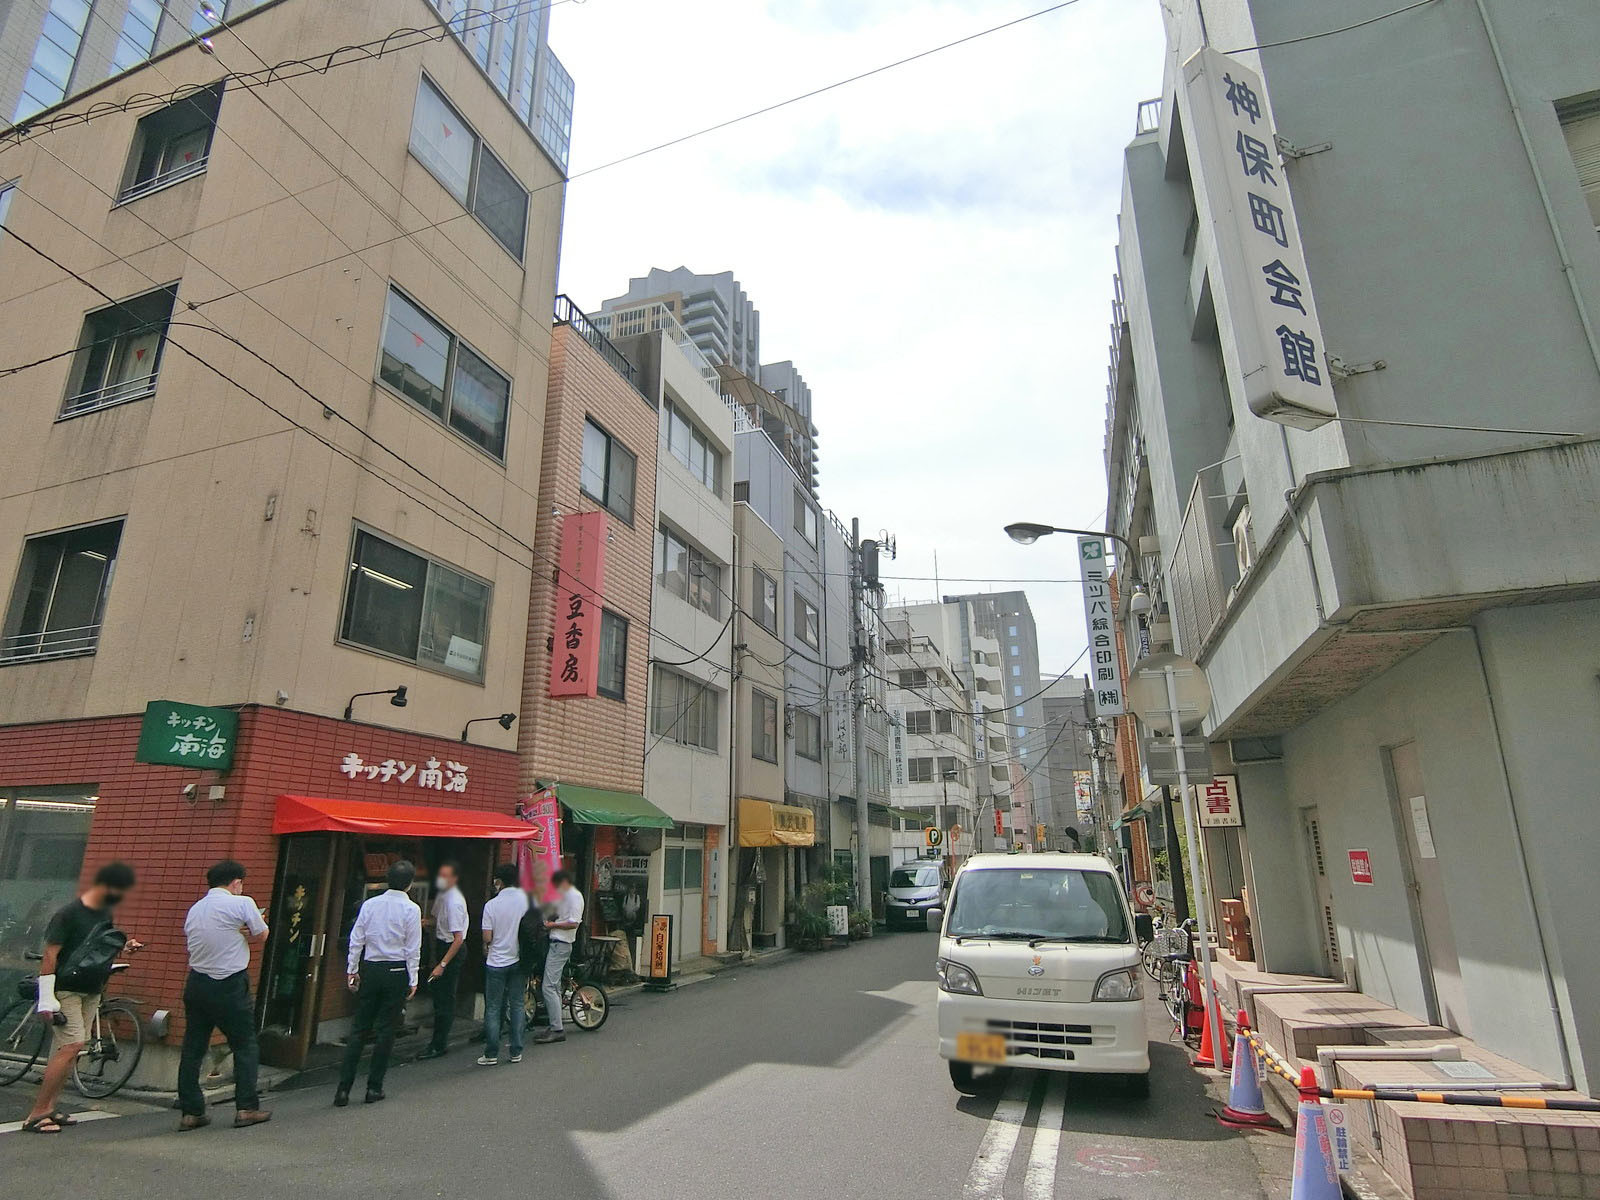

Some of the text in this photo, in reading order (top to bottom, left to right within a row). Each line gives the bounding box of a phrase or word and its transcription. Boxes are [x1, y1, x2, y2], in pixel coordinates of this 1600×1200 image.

[1223, 72, 1322, 387] 神保町会館
[560, 593, 585, 683] 豆香房
[167, 711, 217, 731] キッチン
[169, 728, 227, 759] 南海
[1205, 779, 1232, 815] 古書
[289, 885, 306, 943] キッチン
[655, 932, 664, 970] 自家焙煎
[1016, 987, 1062, 997] HIJET
[1335, 1127, 1349, 1170] 駐輪禁止
